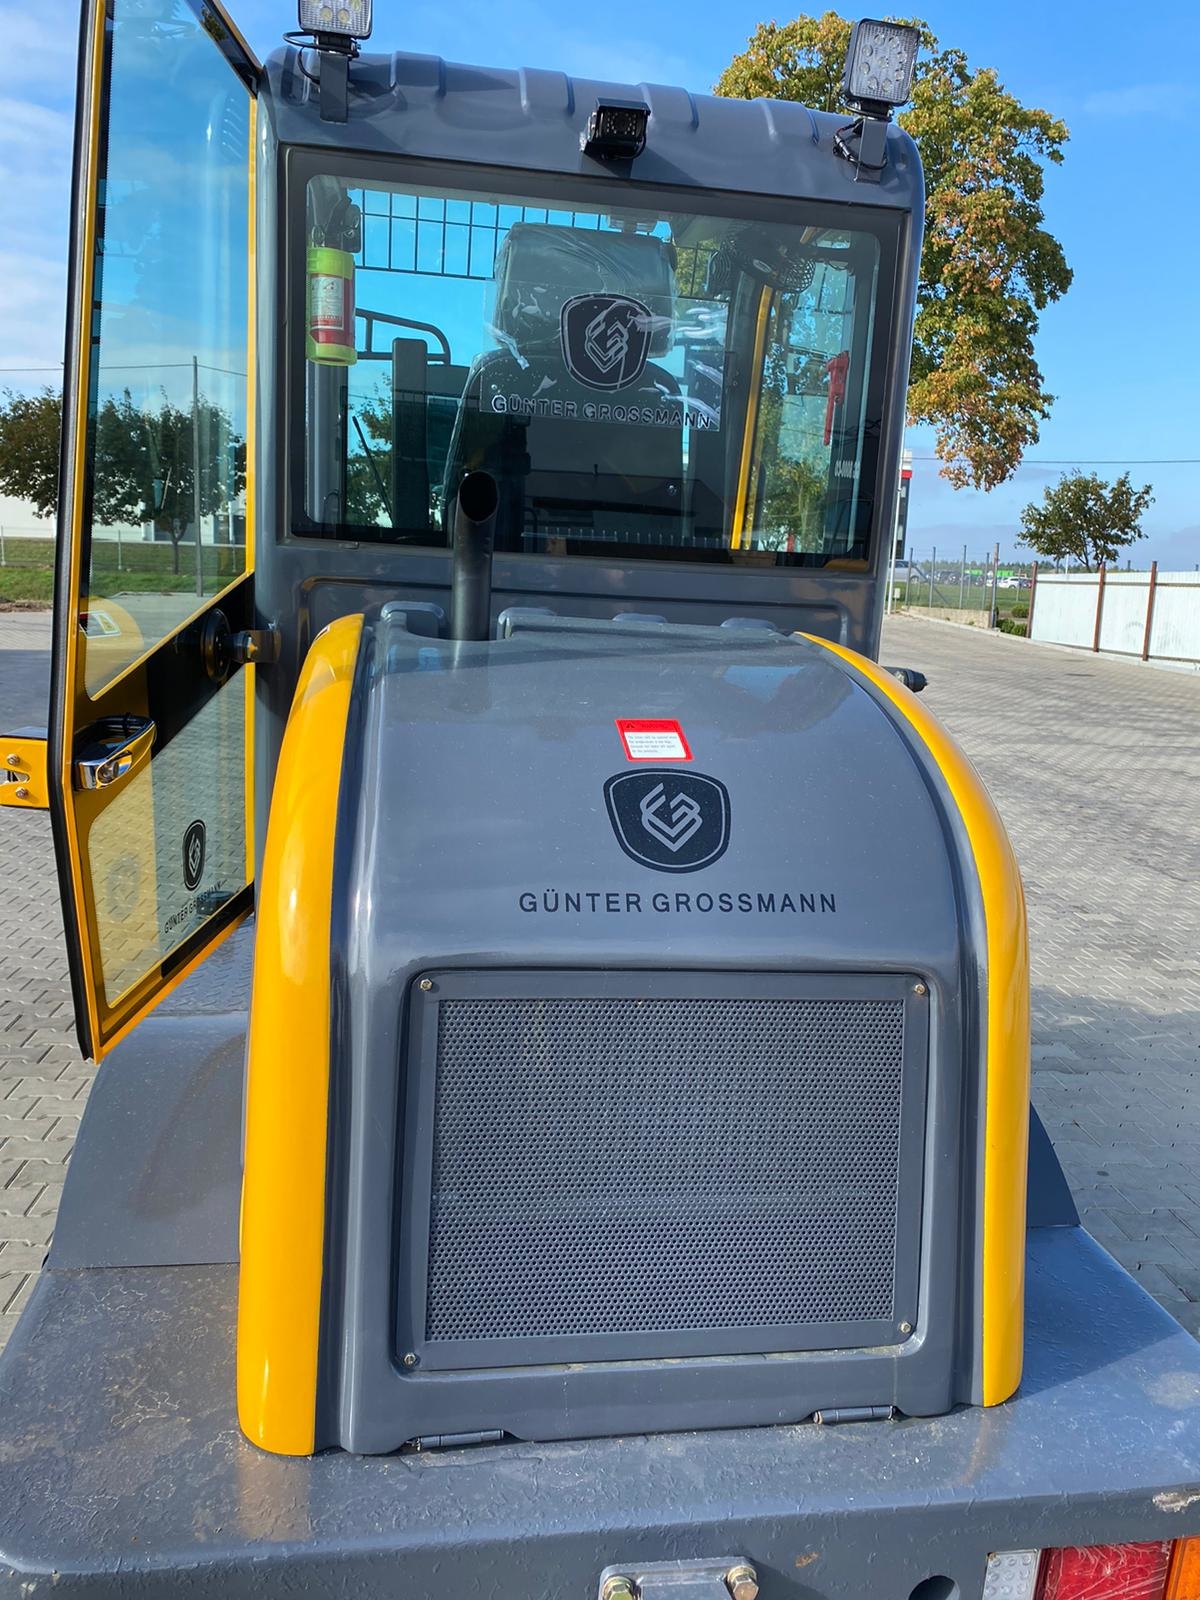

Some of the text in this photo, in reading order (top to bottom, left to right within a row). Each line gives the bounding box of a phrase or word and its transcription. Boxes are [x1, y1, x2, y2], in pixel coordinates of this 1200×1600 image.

[492, 395, 710, 428] GÜNTER GROSSMANN
[519, 888, 836, 913] GÜNTER GROSSMANN
